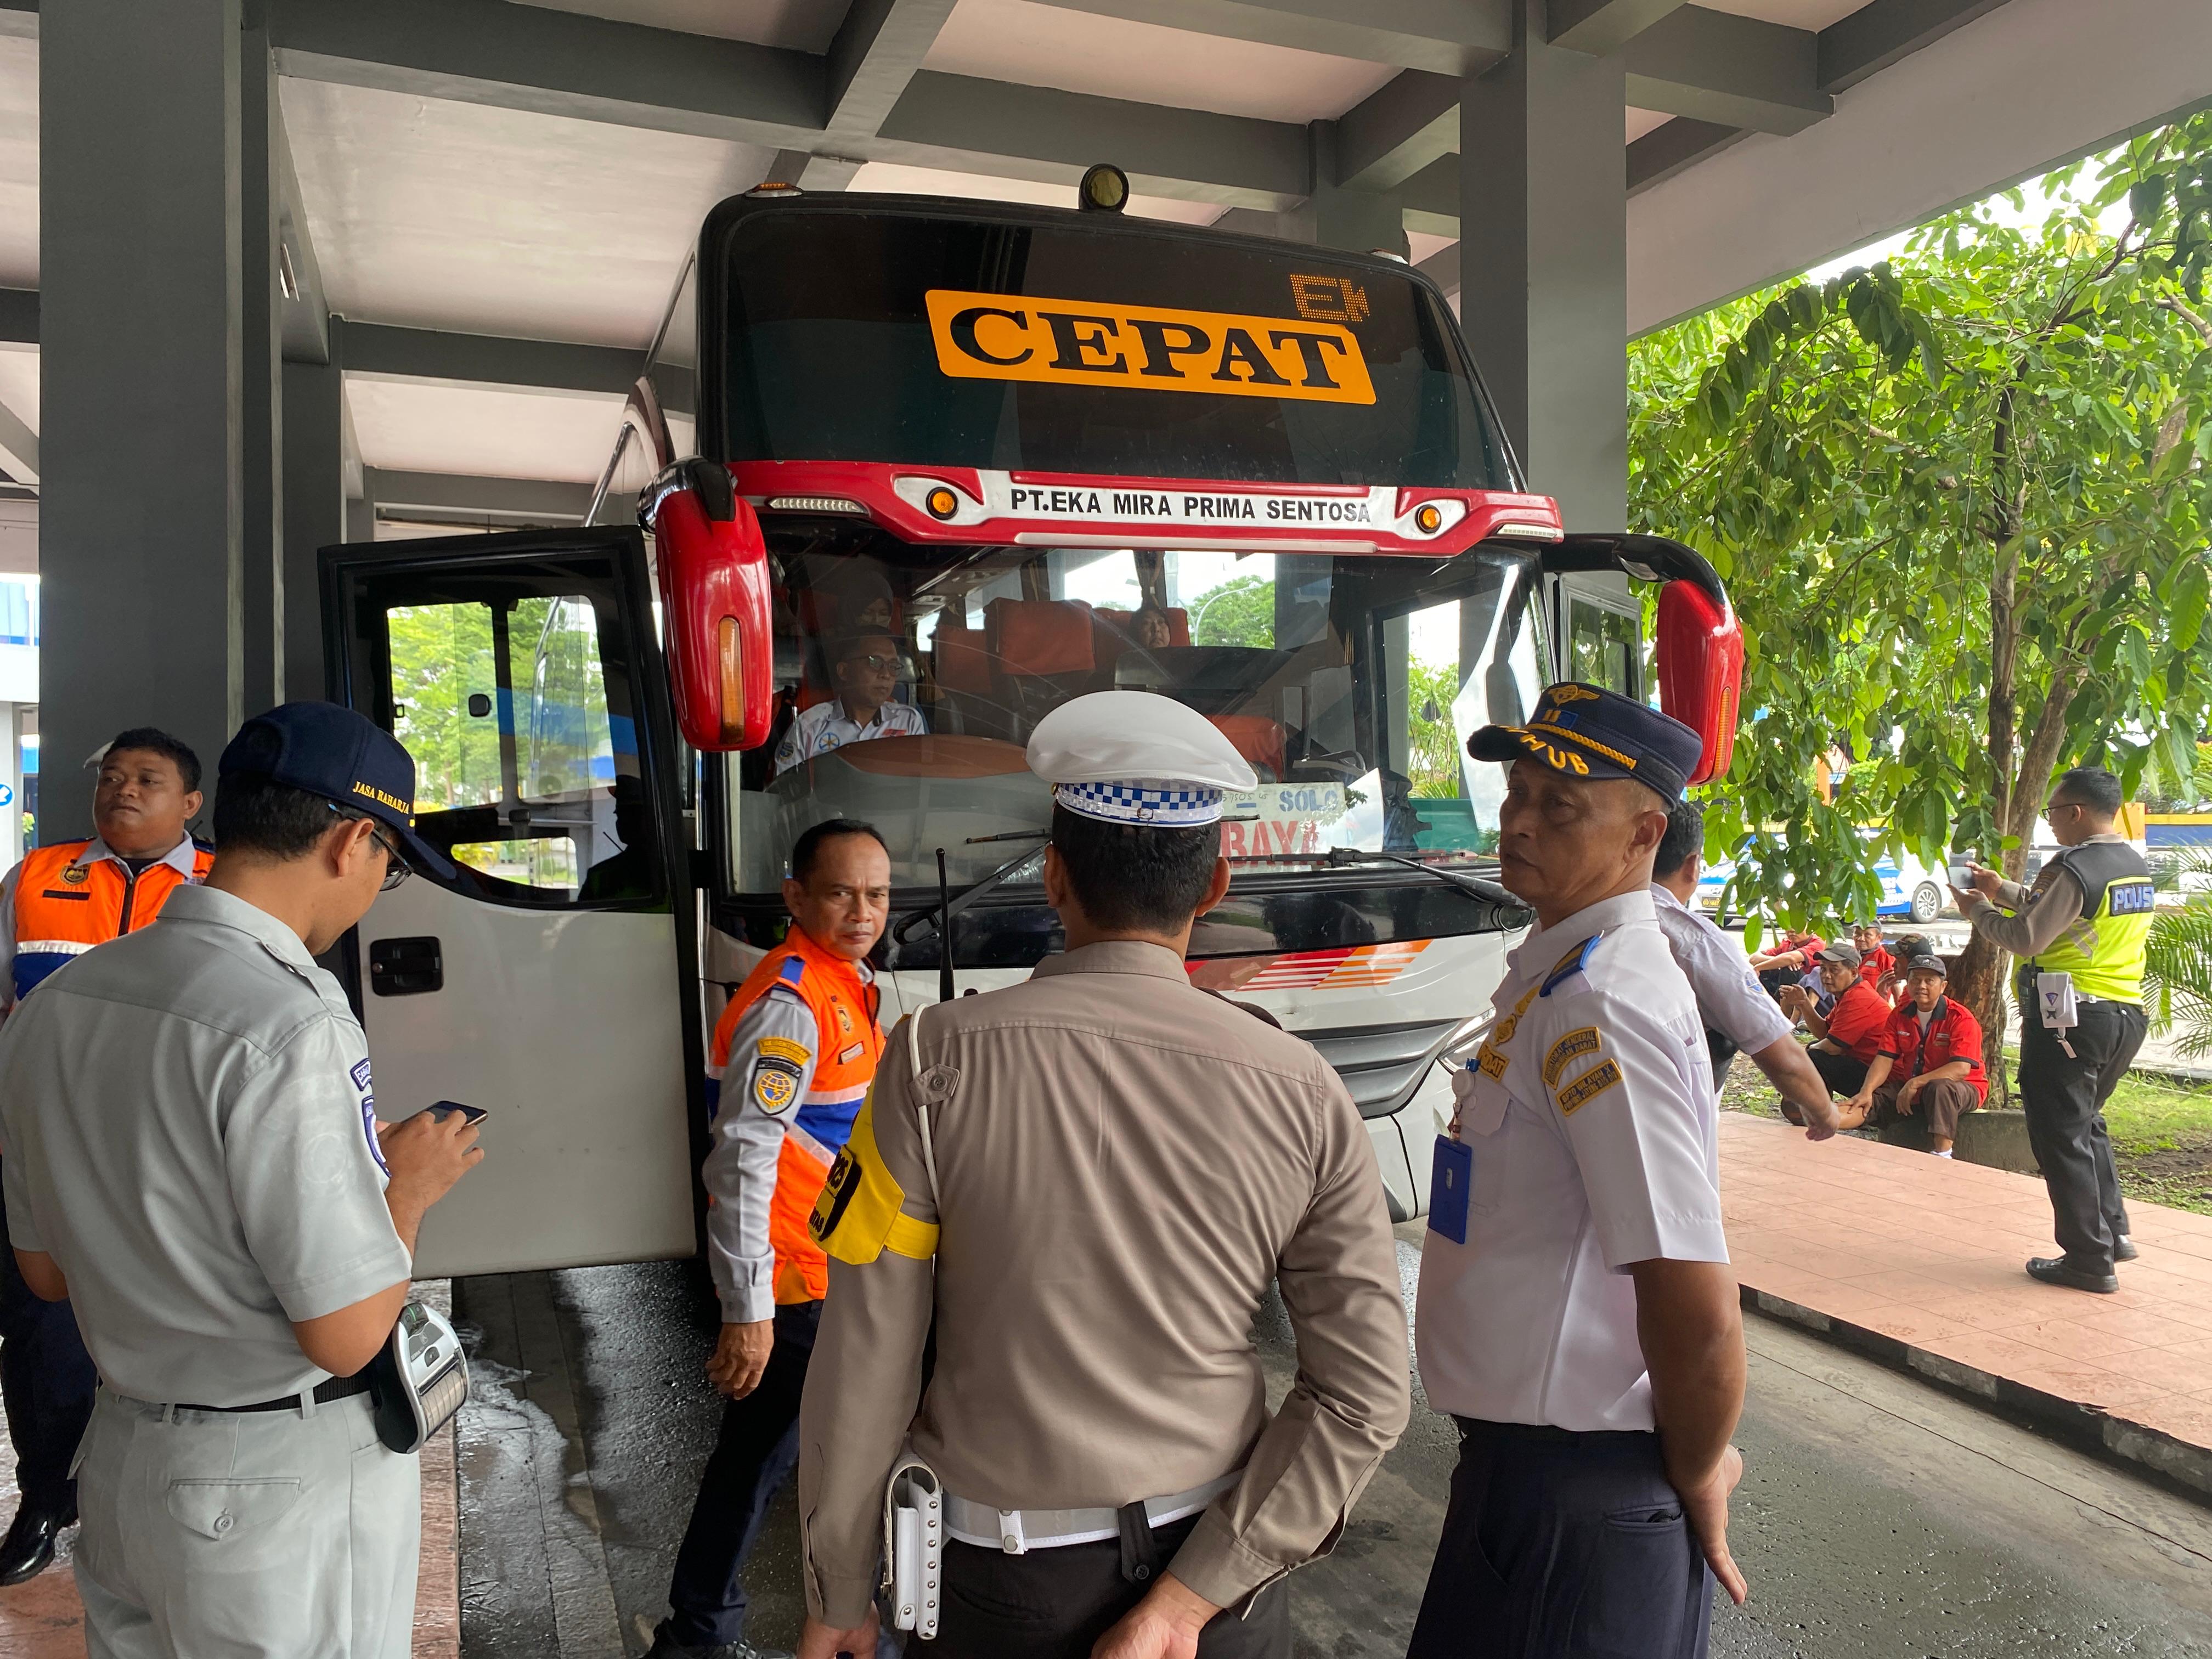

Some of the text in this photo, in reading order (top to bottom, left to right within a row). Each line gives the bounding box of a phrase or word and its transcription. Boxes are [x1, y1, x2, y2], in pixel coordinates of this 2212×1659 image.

[950, 307, 1347, 388] CEPAT
[1011, 489, 1371, 523] PT.EKA MIRA PRIMA SENTOSA
[353, 781, 409, 814] JASA RAHARJA
[1279, 789, 1339, 812] SOLO
